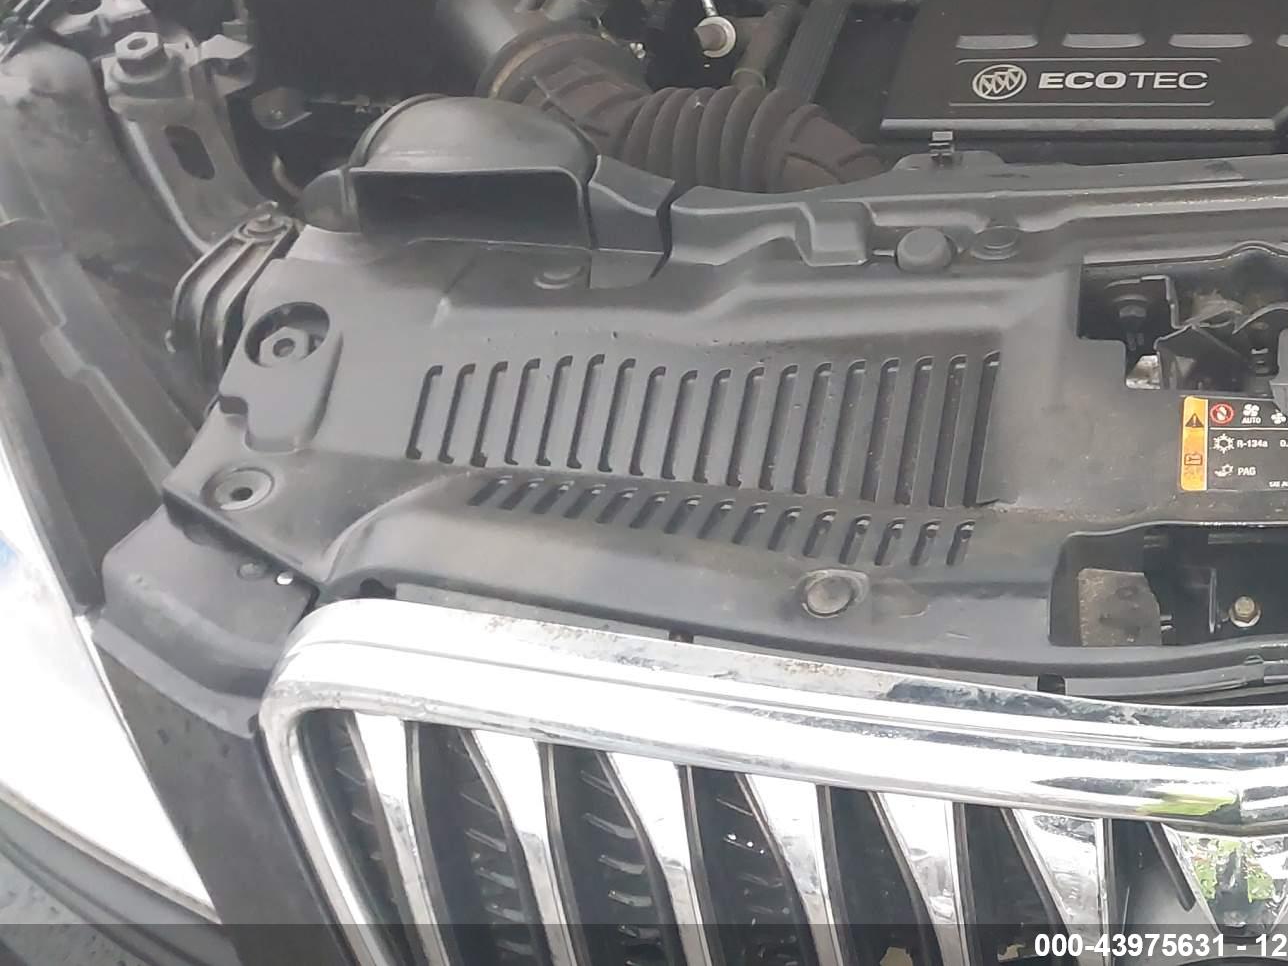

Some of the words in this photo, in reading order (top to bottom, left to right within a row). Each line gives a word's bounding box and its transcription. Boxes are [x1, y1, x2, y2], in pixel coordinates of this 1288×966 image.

[1038, 71, 1208, 89] ECOTEC
[1236, 439, 1268, 448] R-134a
[1237, 467, 1256, 475] PAG
